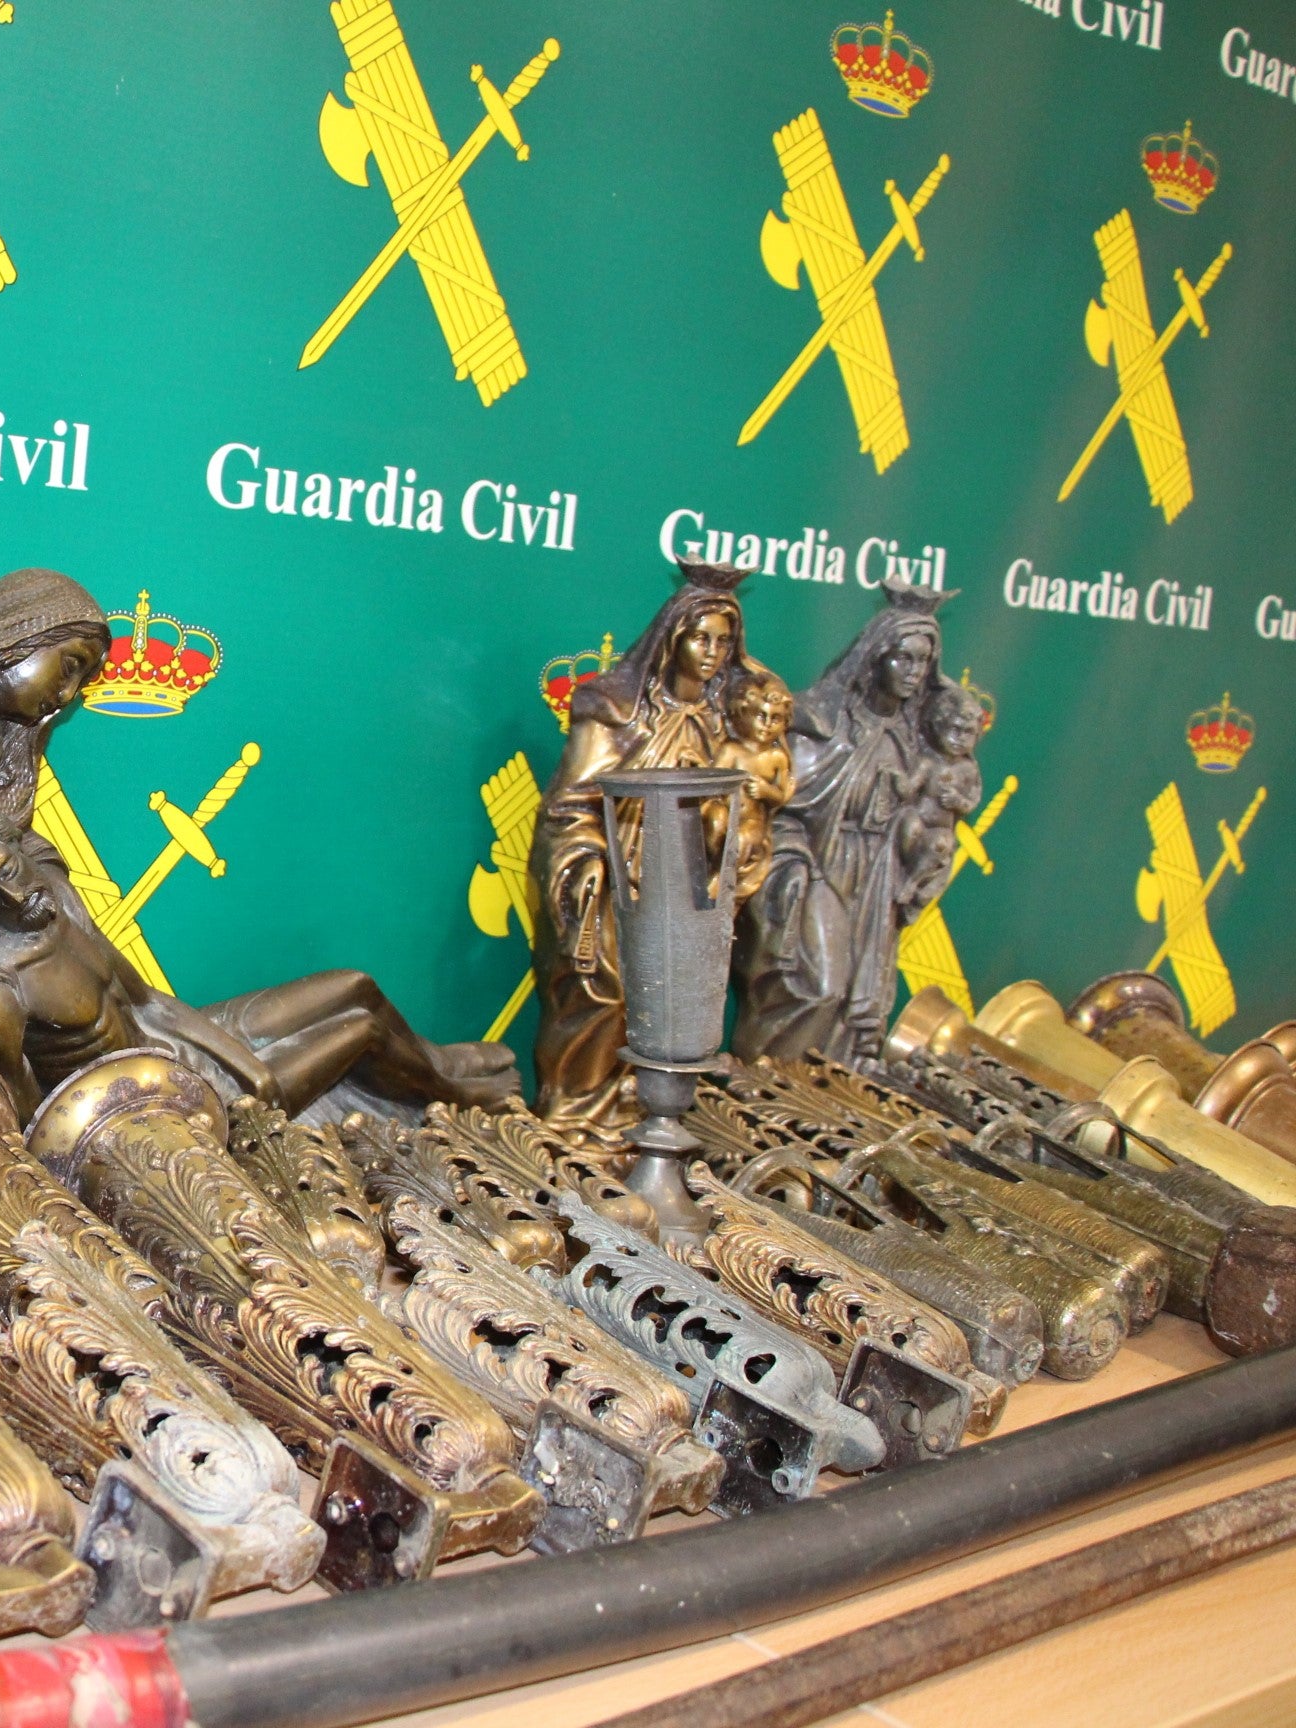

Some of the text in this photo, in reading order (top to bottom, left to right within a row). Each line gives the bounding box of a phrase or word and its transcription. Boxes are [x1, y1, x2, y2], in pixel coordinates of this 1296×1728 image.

[1071, 0, 1164, 50] Civil
[1220, 26, 1296, 103] Guar
[206, 442, 578, 551] Guardia Civil
[659, 508, 947, 593] Guardia Civil
[1004, 558, 1213, 631] Guardia Civil
